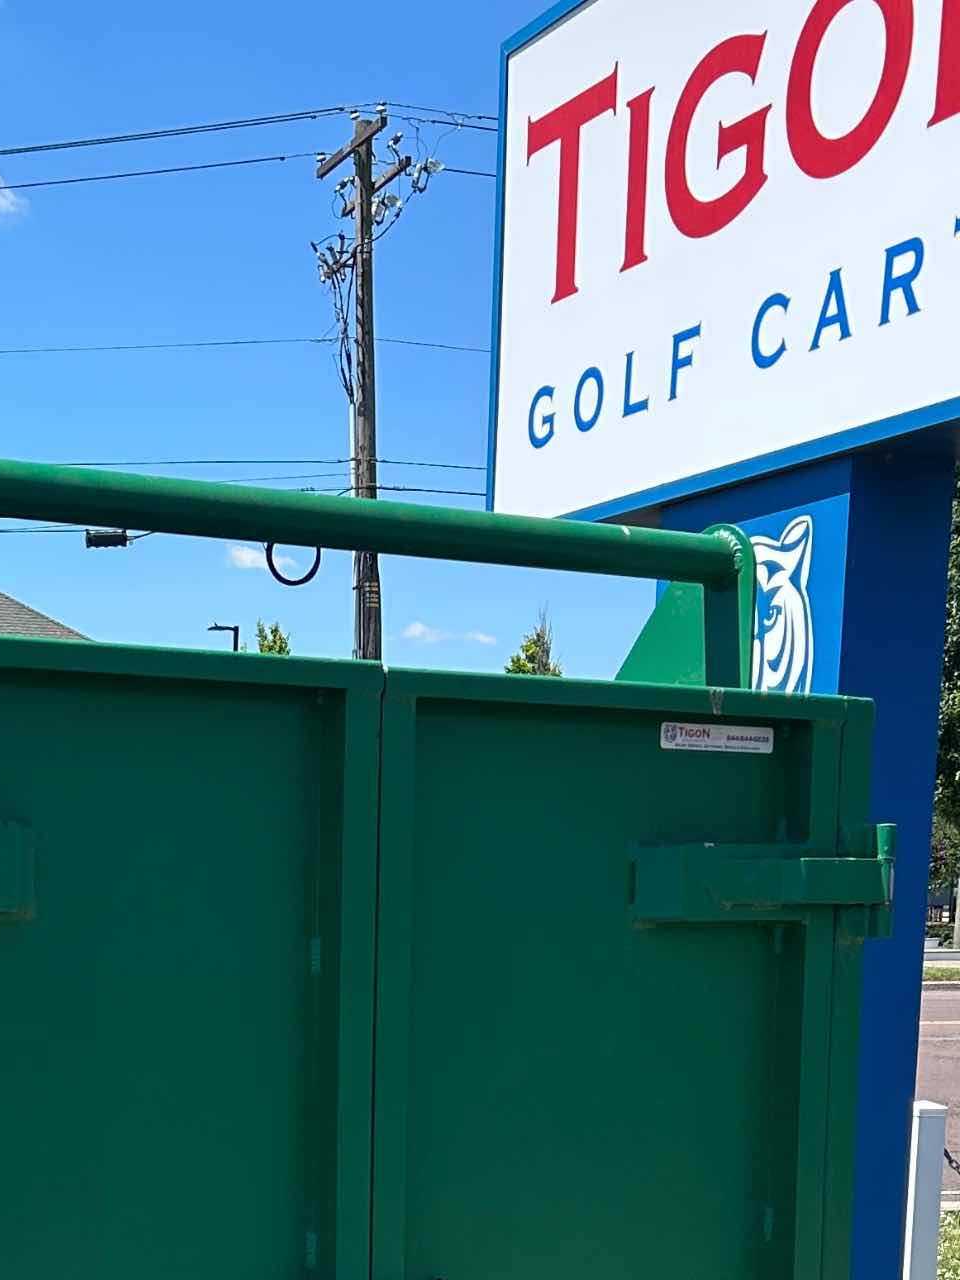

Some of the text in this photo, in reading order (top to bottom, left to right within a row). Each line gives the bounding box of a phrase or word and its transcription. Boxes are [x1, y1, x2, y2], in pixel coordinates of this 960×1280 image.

[526, 0, 960, 304] TIGO
[527, 215, 960, 449] GOLF CAR
[678, 726, 711, 739] TIGON
